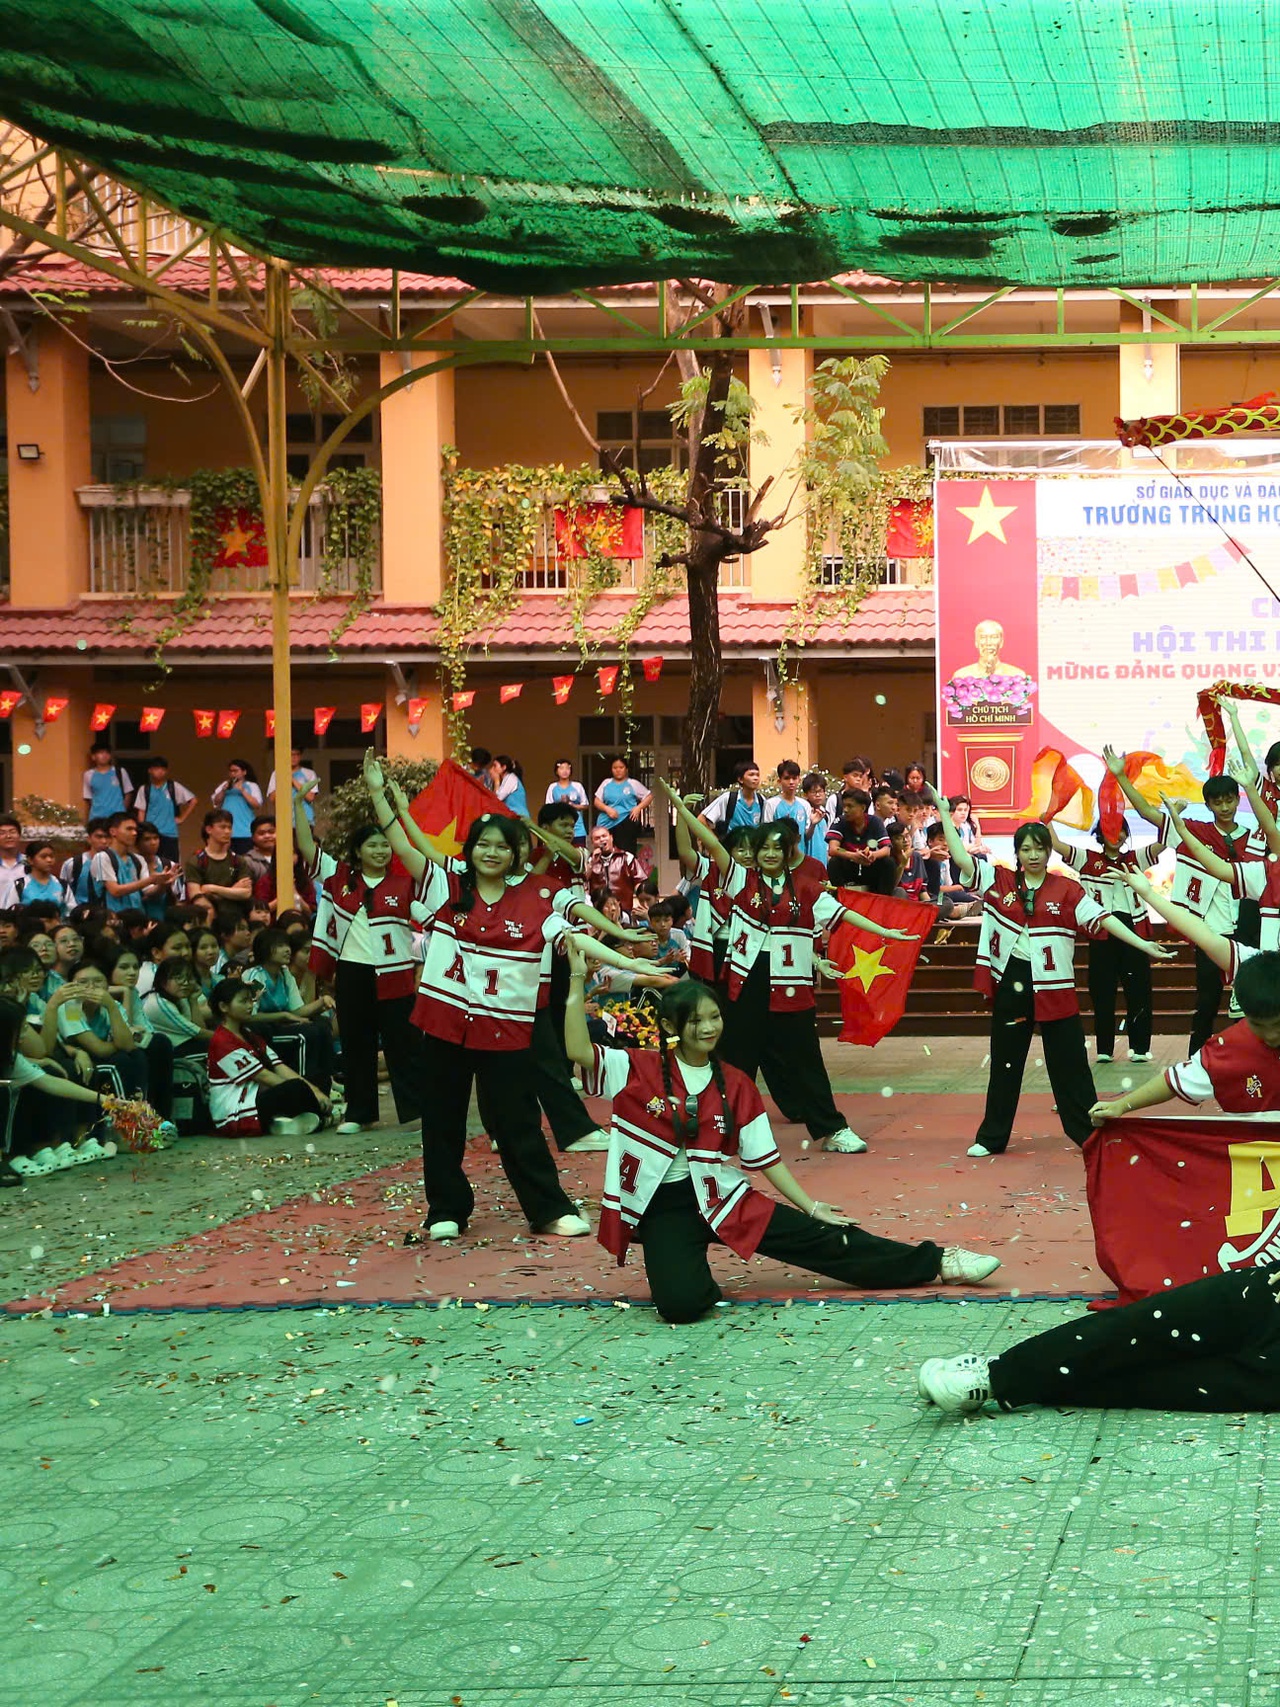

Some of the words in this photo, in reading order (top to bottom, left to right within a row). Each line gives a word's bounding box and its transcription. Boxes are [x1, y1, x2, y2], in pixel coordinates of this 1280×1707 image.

[1199, 485, 1229, 501] DỤC
[1082, 499, 1171, 525] TRƯỜNG
[1179, 504, 1251, 525] TRUNG
[1133, 625, 1196, 659] HỘI
[1204, 631, 1266, 652] THI
[1047, 661, 1109, 680] MỪNG
[1115, 659, 1175, 679] ĐẢNG
[1181, 664, 1257, 679] QUANG
[994, 714, 1016, 723] MINH
[1186, 876, 1203, 904] A
[382, 932, 396, 956] 1
[782, 943, 794, 967] 1
[1042, 944, 1057, 972] 1
[444, 951, 467, 986] A
[483, 968, 500, 996] 1
[619, 1150, 642, 1196] A
[702, 1174, 726, 1210] 1
